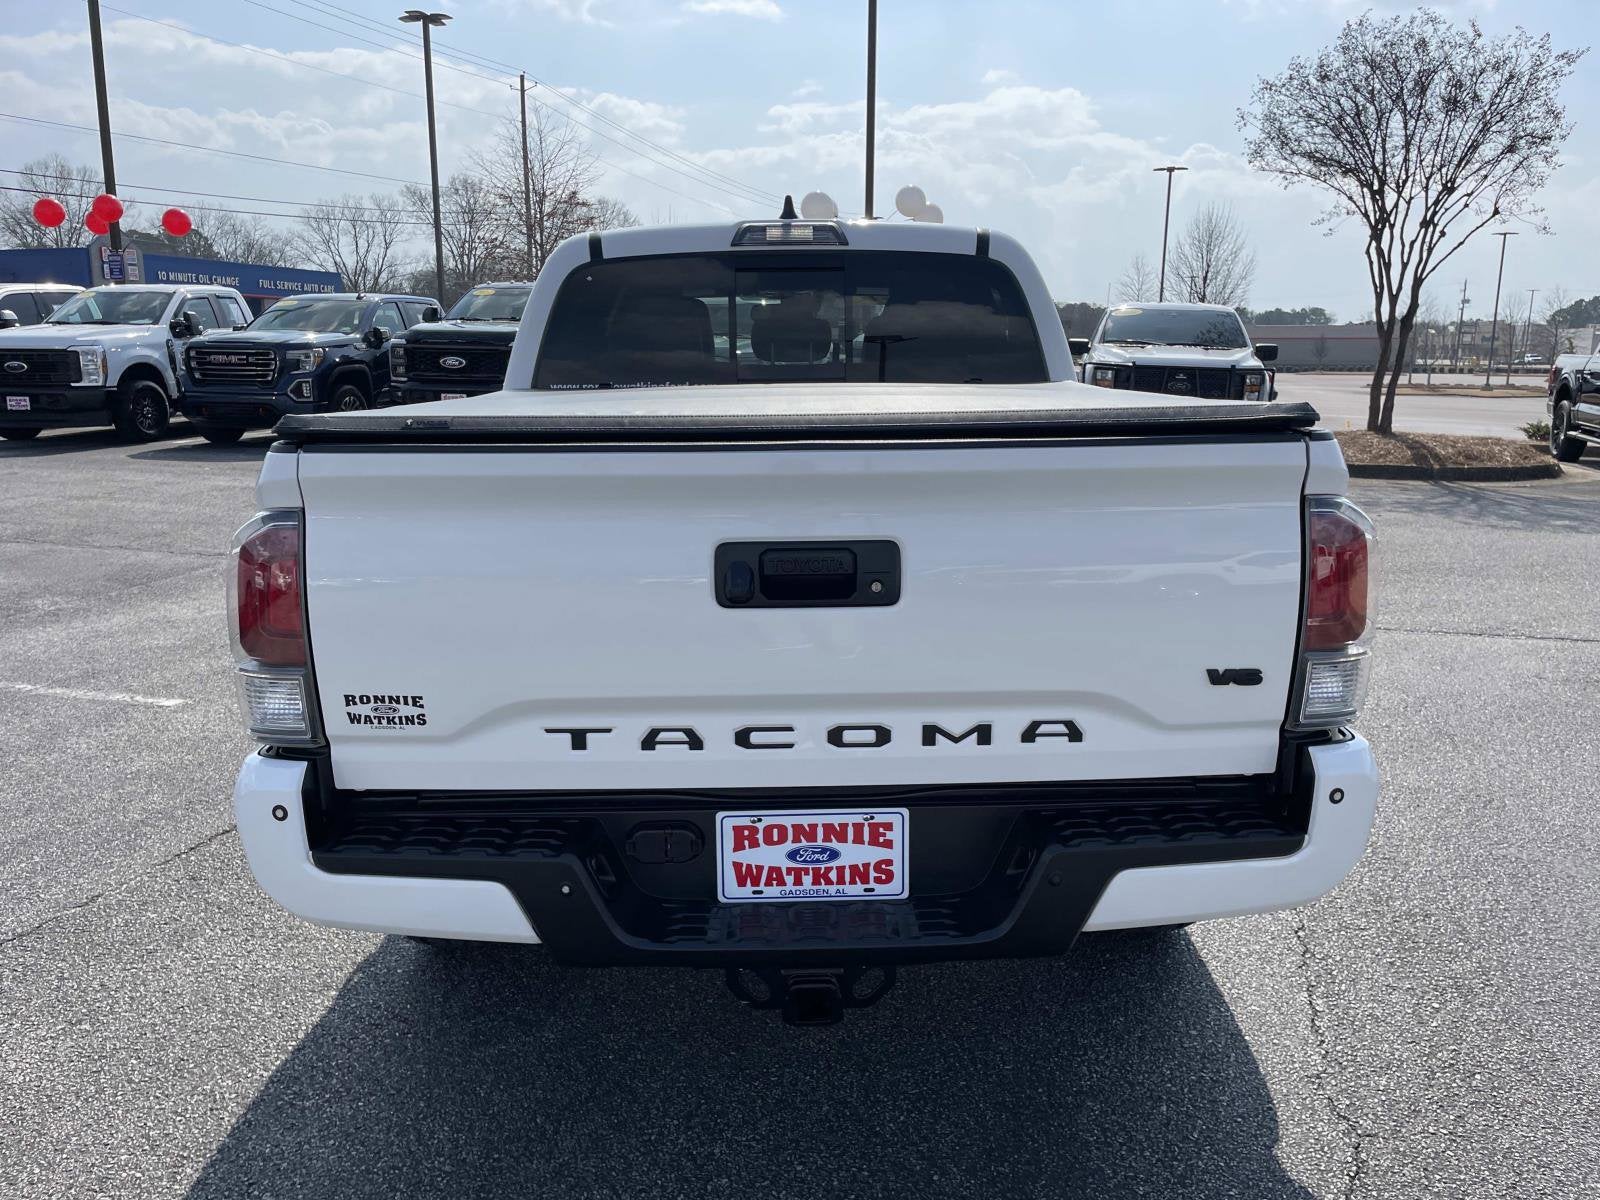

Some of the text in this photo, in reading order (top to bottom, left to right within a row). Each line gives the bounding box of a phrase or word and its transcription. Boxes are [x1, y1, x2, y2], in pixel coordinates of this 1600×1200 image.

[158, 271, 240, 286] 10 MINUTE OIL CHANGE
[259, 280, 335, 294] FULL SERVICE AUTO CARE
[768, 559, 848, 572] TOYOTA
[1206, 668, 1264, 686] V6
[343, 694, 425, 709] RONNIE
[346, 711, 427, 726] WATKINS
[544, 720, 1084, 751] TACOMA
[732, 821, 894, 853] RONNIE
[796, 848, 830, 862] Ford
[732, 858, 895, 888] WATKINS
[779, 888, 848, 897] GADSDEN, AL
